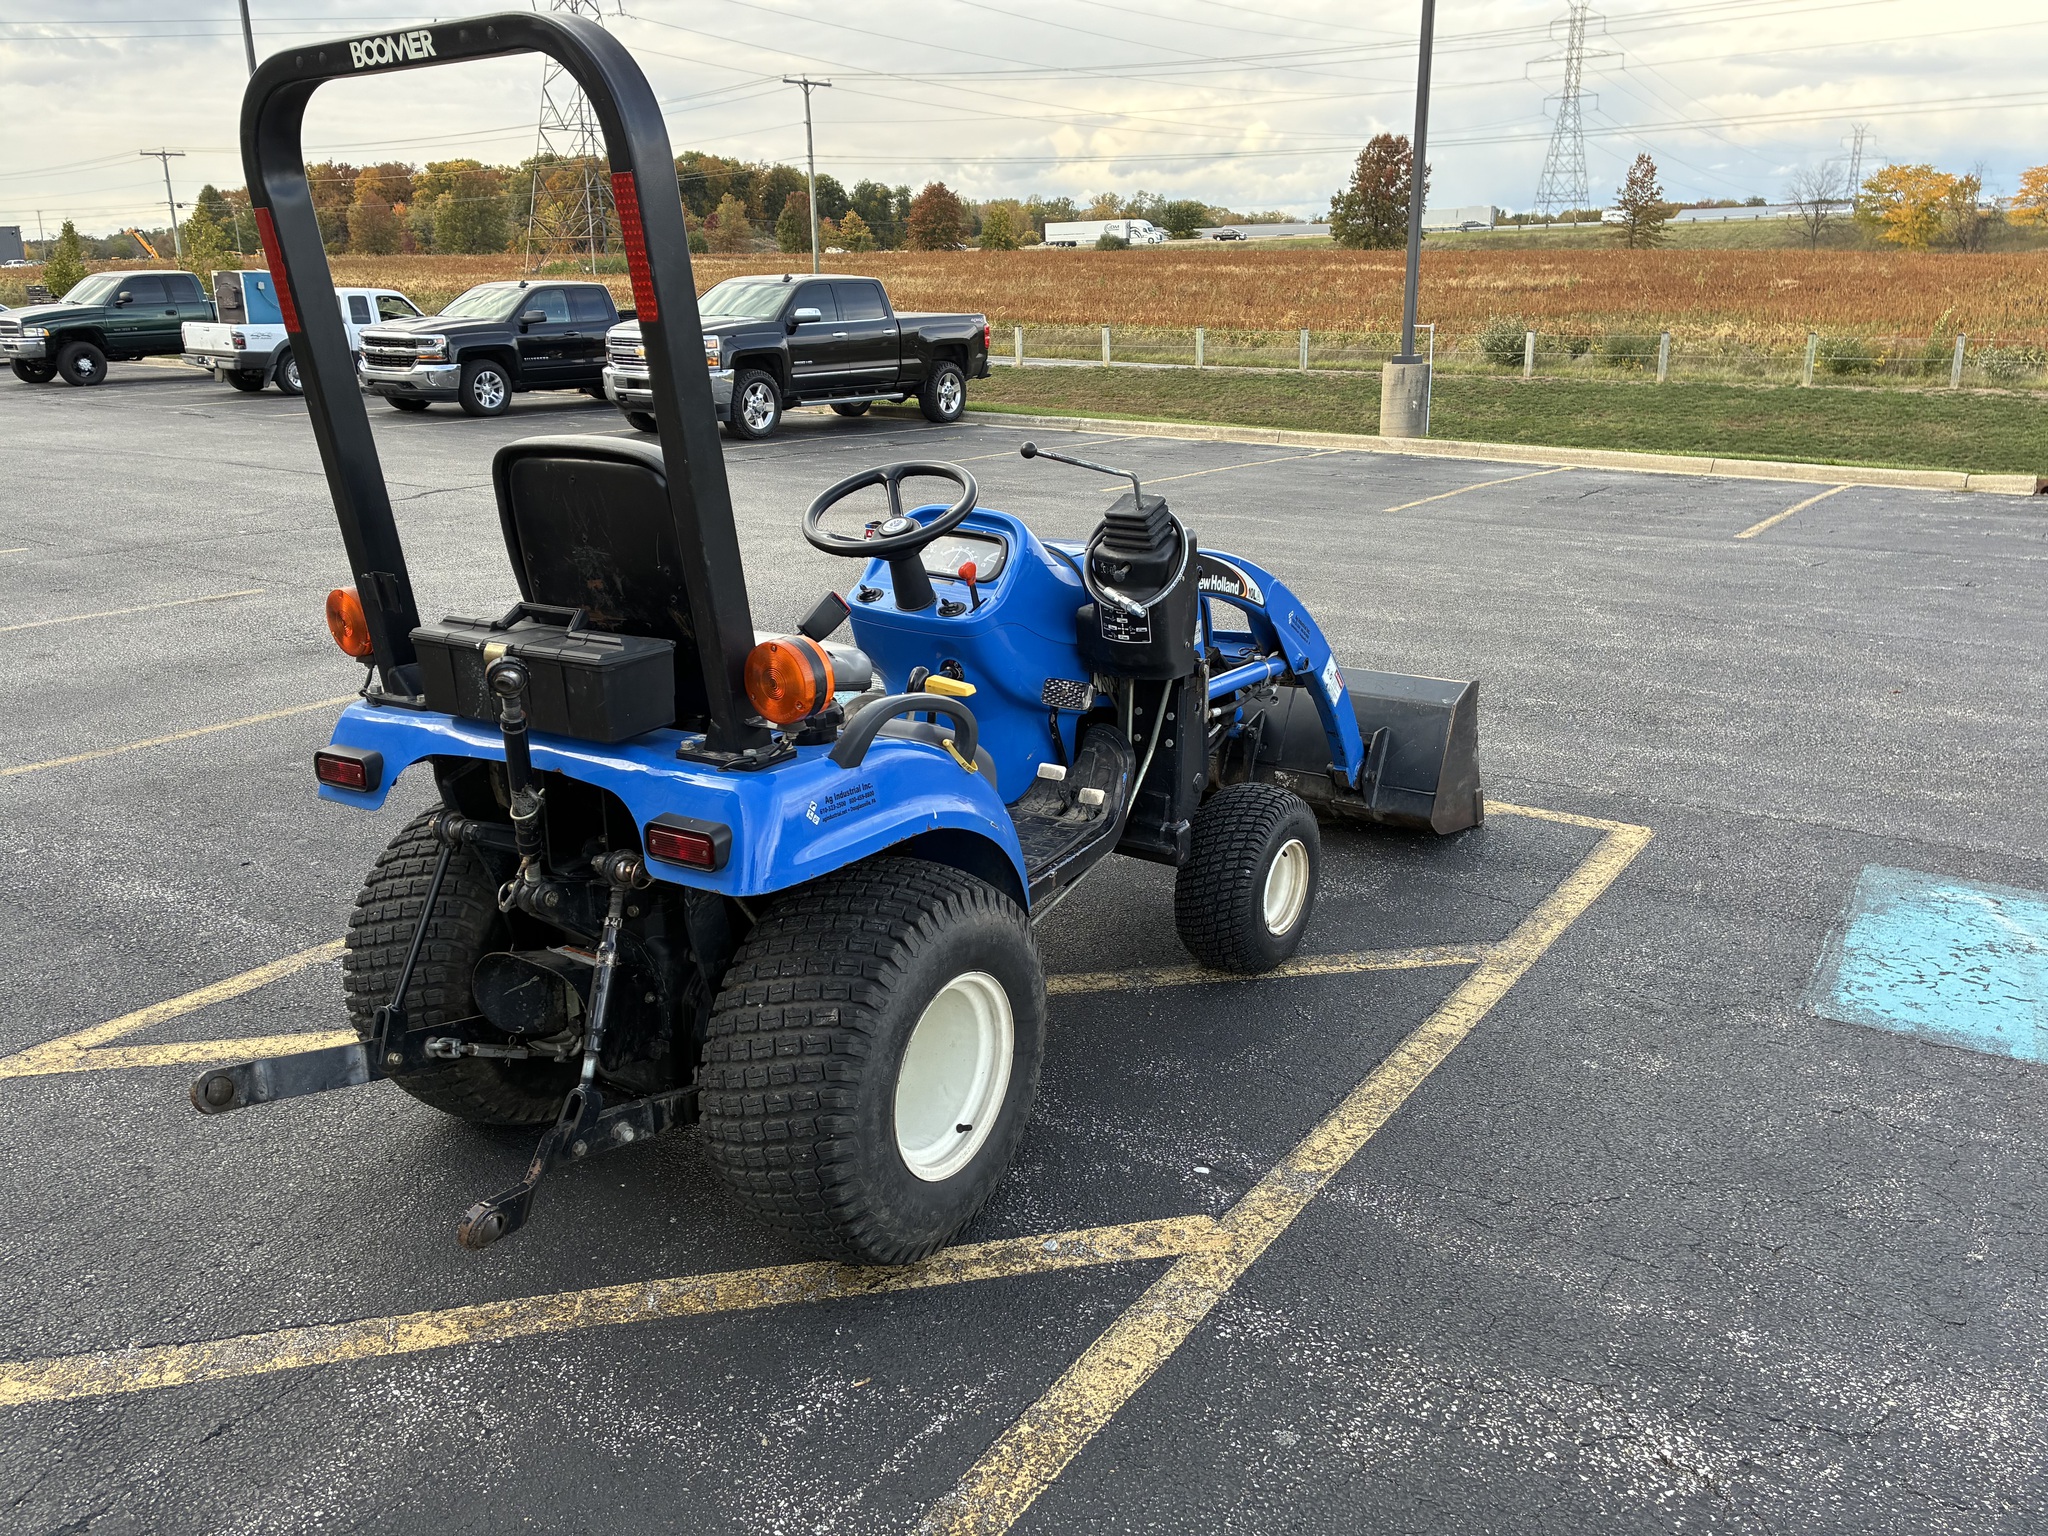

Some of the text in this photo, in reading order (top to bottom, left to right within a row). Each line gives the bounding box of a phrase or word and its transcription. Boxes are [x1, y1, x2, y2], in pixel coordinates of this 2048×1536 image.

[349, 30, 437, 68] BOOMER
[1198, 574, 1240, 595] ew Holland
[825, 783, 873, 804] Ag Industrial Inc.
